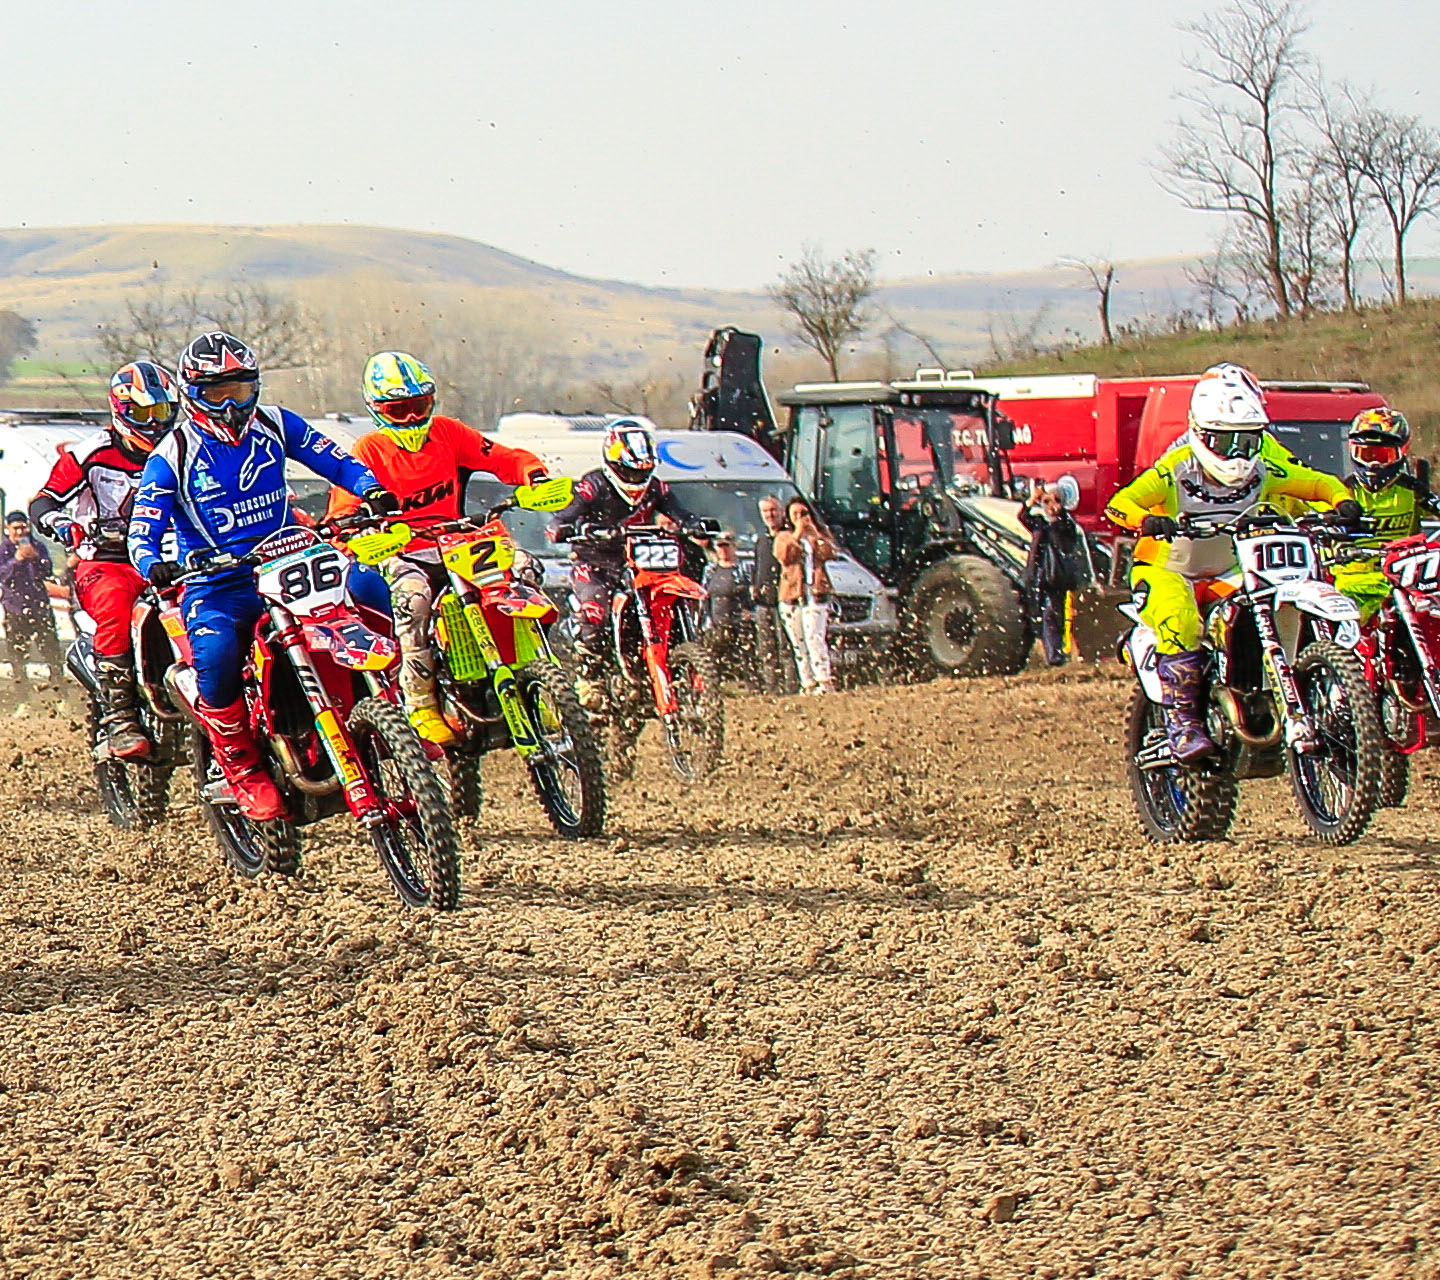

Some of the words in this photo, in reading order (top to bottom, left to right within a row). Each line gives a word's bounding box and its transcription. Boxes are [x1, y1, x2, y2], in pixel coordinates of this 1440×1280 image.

[470, 541, 496, 575] 2
[634, 543, 679, 566] 223
[279, 553, 342, 603] 86
